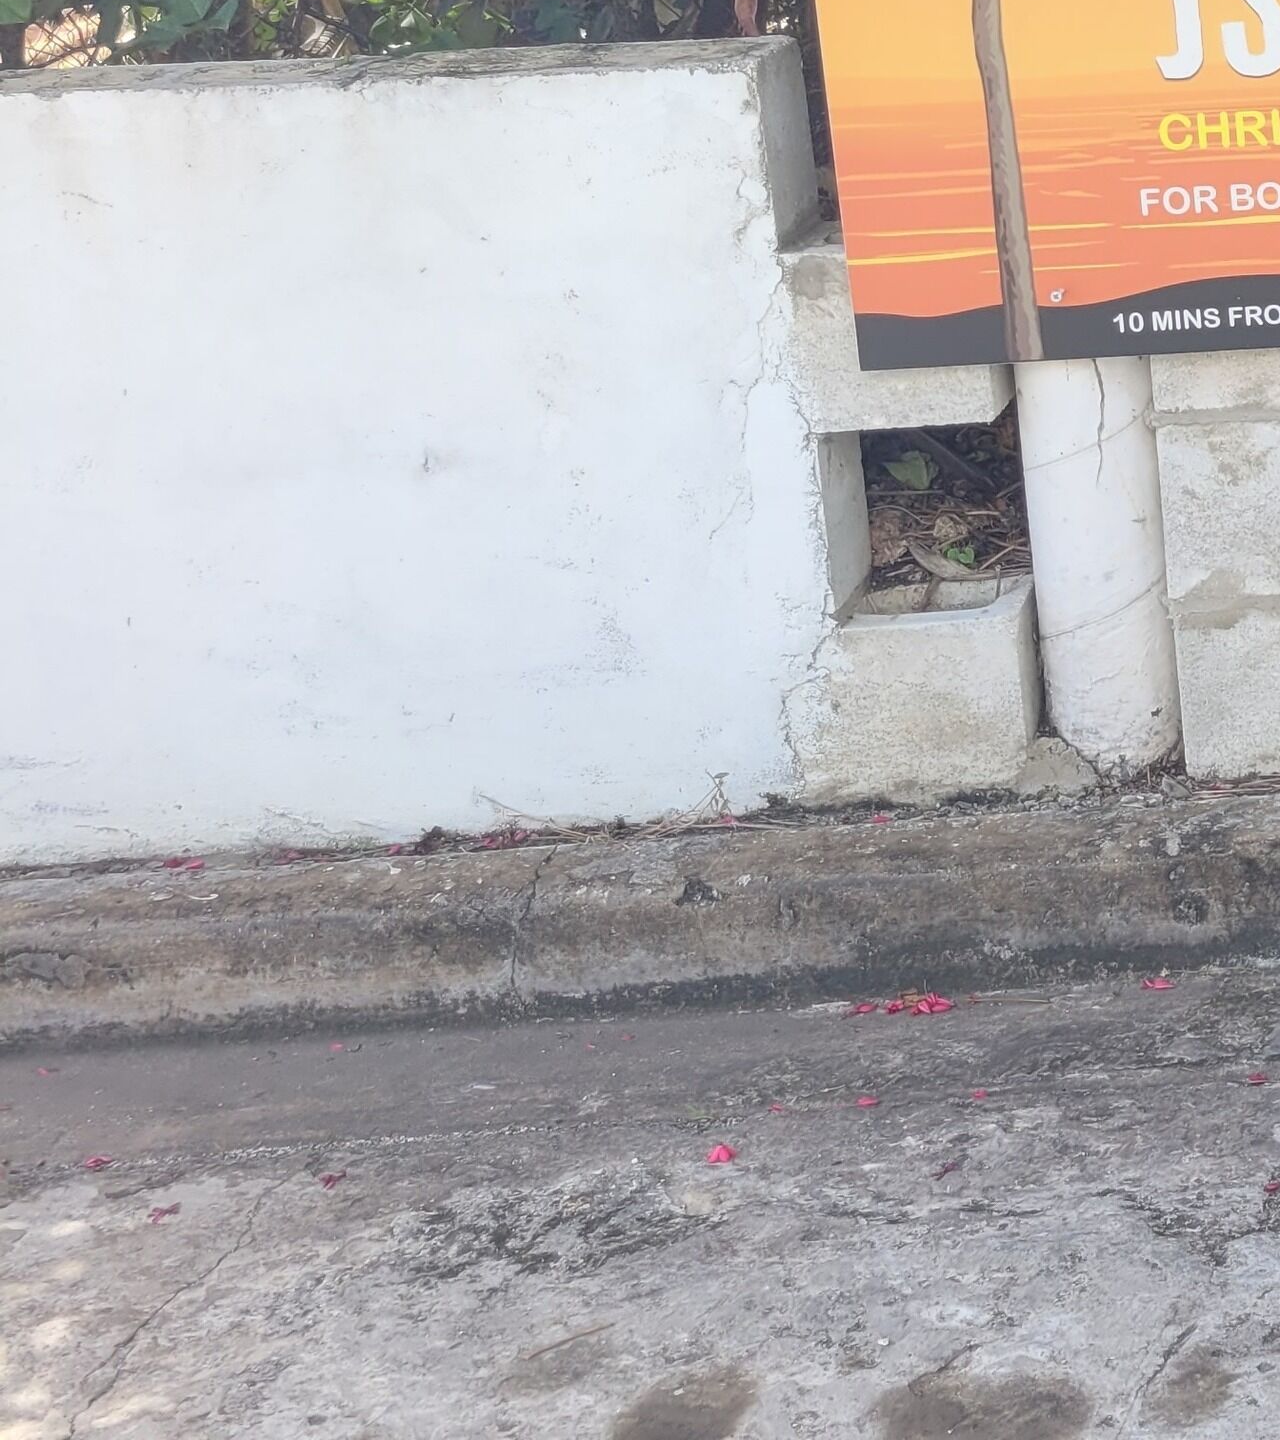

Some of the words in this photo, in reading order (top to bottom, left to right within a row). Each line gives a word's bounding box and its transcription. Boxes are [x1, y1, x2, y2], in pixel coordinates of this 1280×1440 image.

[1139, 185, 1219, 217] FOR
[1112, 312, 1145, 334] 10
[1151, 308, 1222, 332] MINS
